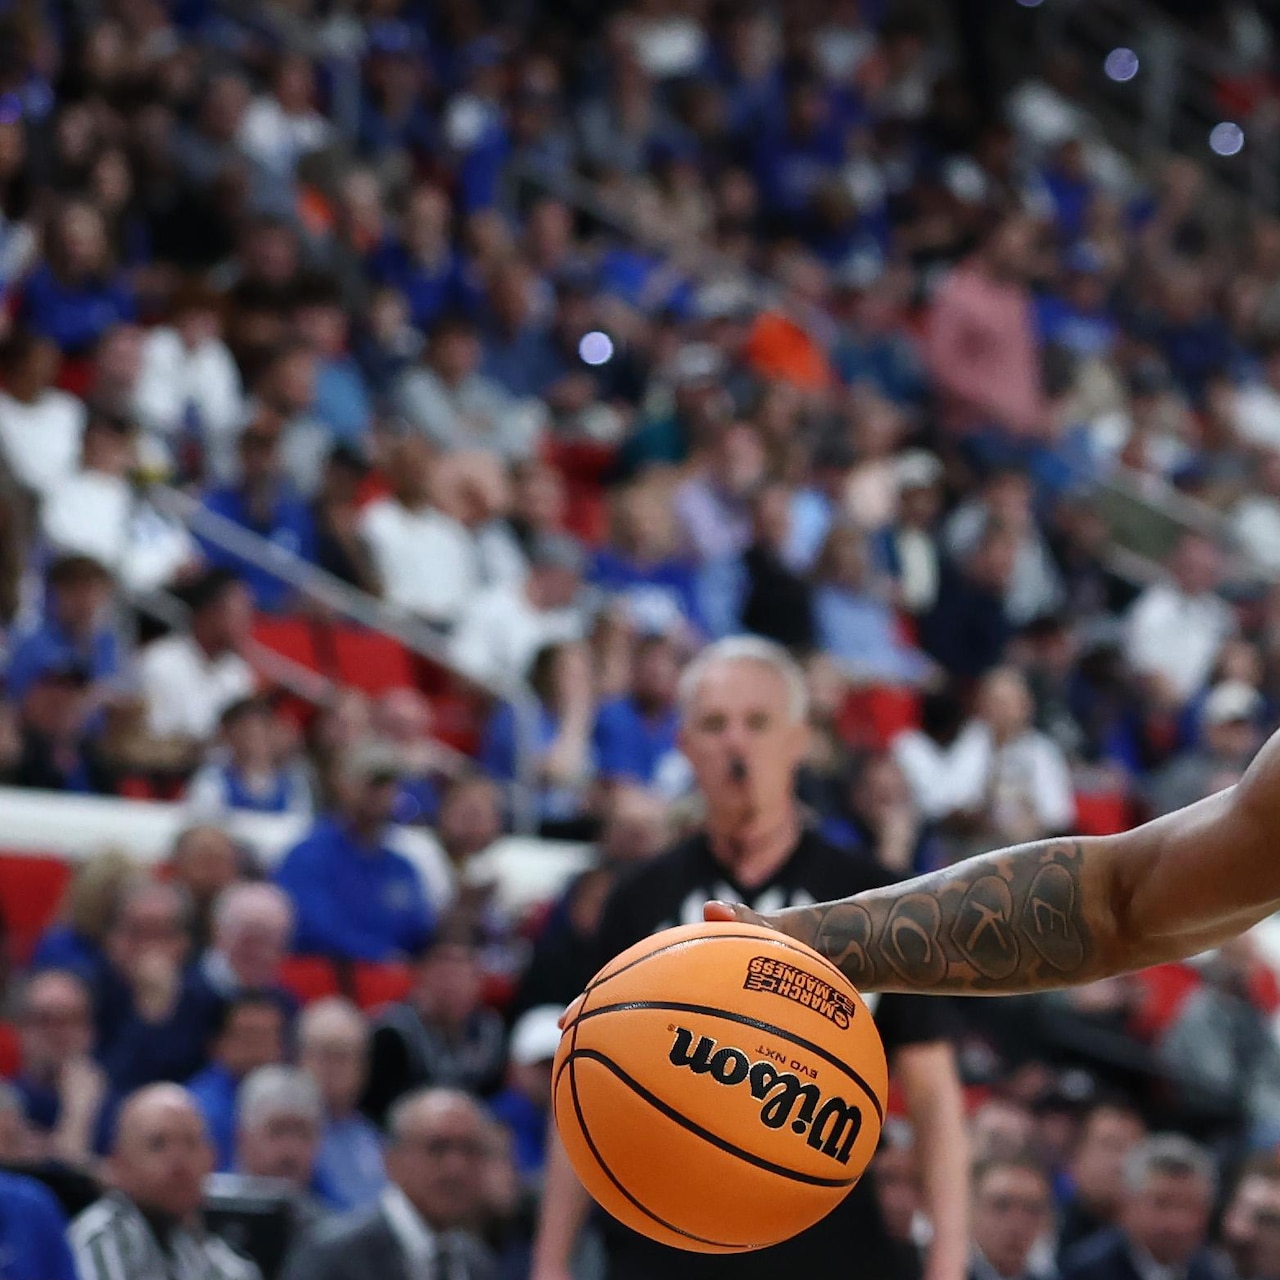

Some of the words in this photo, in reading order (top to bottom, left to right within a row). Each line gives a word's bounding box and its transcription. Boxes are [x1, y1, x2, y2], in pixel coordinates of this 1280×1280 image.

[749, 957, 830, 1000] MADNESS
[777, 980, 836, 1020] MARCH
[755, 1045, 787, 1064] NXT
[790, 1060, 819, 1080] EVO
[669, 1026, 863, 1166] Wilson
